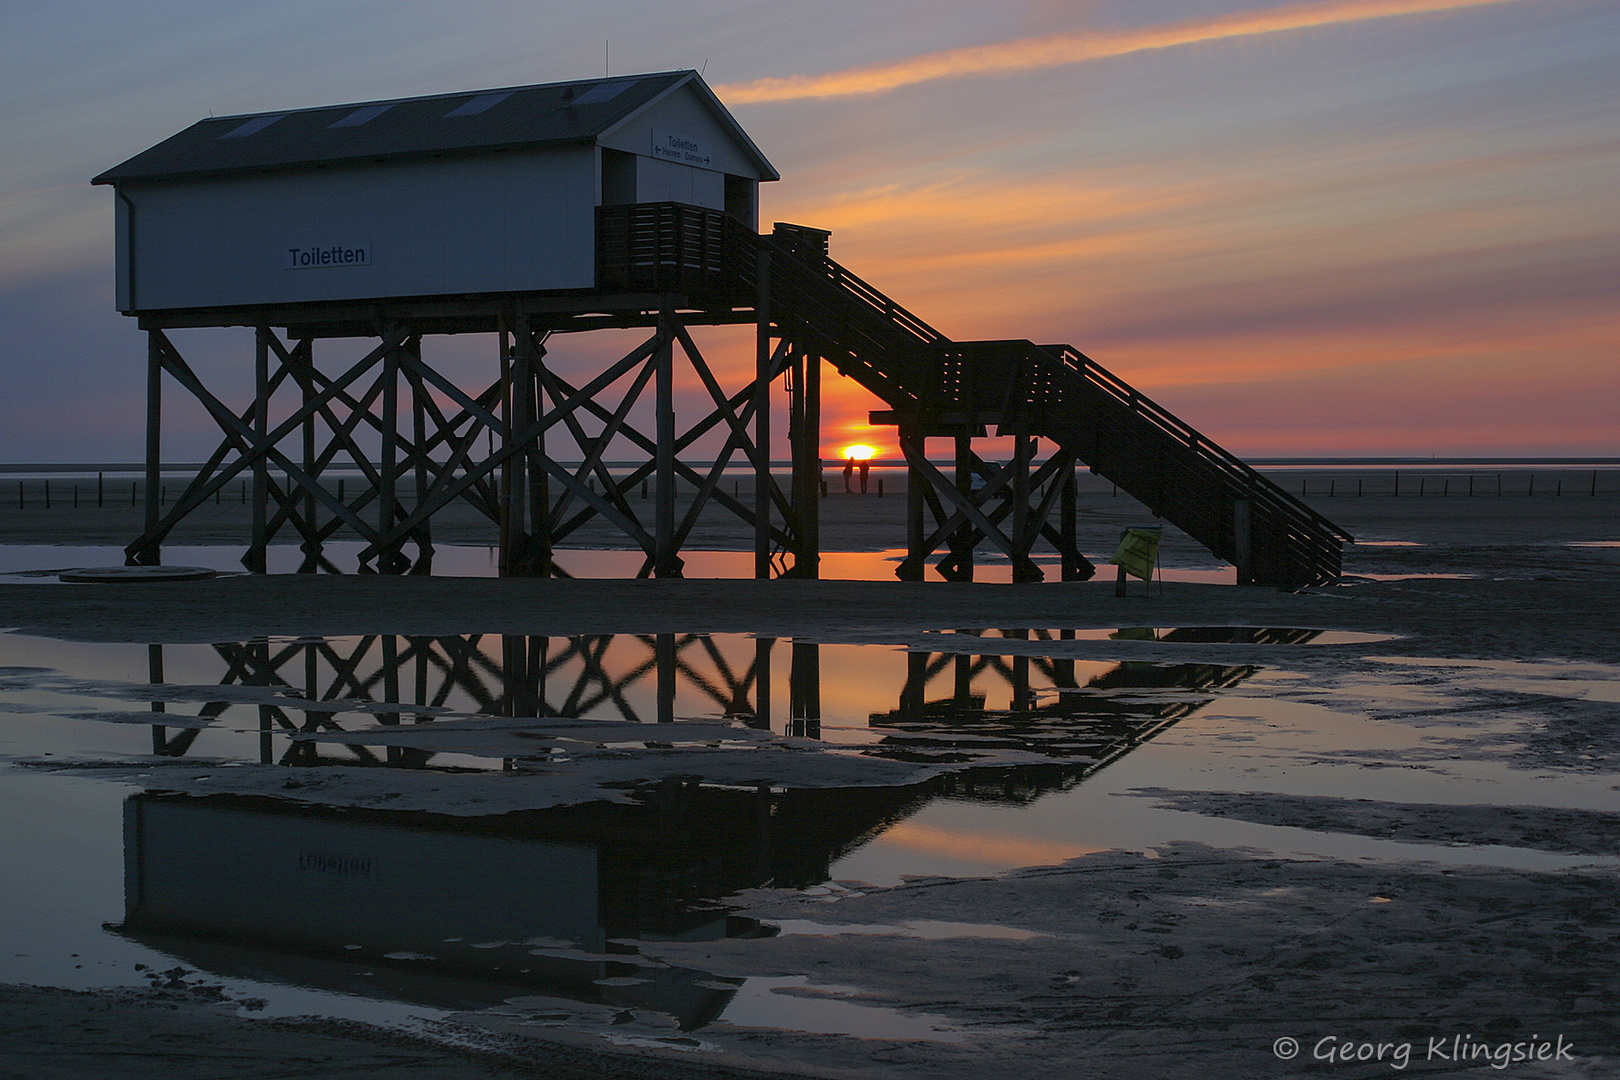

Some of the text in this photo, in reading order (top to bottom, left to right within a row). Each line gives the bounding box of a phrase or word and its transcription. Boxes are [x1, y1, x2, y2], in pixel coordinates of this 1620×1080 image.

[668, 135, 698, 152] Toiletten
[662, 147, 703, 163] Herren Damen
[289, 246, 365, 266] Toiletten
